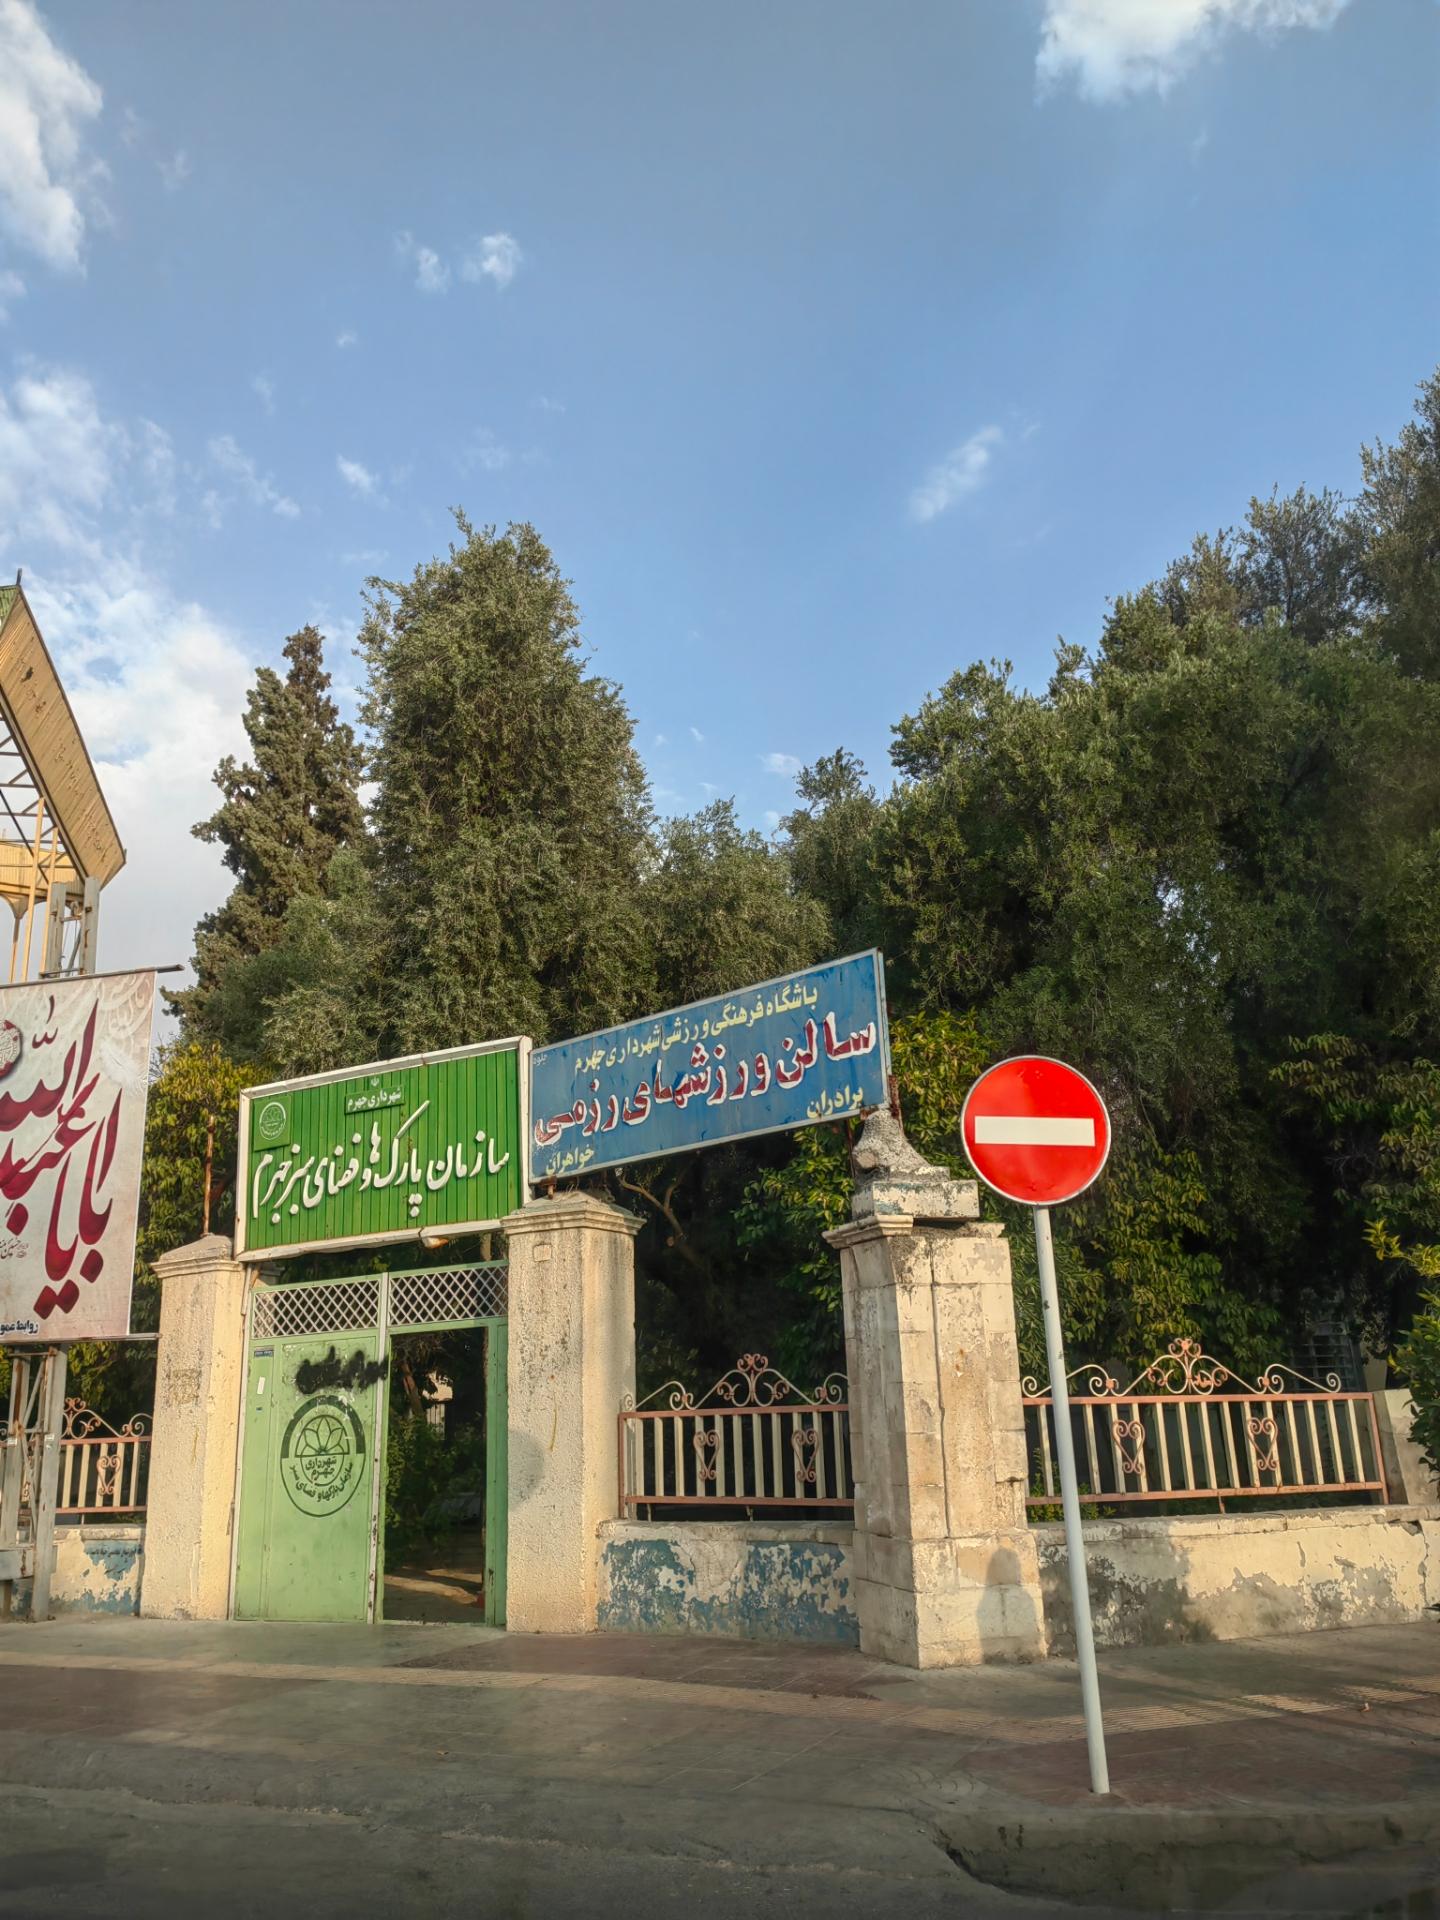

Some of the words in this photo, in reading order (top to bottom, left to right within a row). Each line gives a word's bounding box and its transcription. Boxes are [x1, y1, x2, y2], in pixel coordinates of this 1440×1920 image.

[711, 995, 764, 1036] فرهنگی
[766, 983, 818, 1016] باشگاه
[605, 1024, 660, 1067] شهرداری
[775, 1011, 876, 1089] سالن
[575, 1049, 606, 1079] جهرم
[347, 1096, 367, 1112] جهرم
[367, 1086, 401, 1108] شهرداری
[534, 1078, 619, 1146] رزمی
[806, 1084, 864, 1119] برادران
[303, 1132, 361, 1208] فضای
[426, 1131, 510, 1190] سازمان
[545, 1144, 595, 1176] خواهران
[253, 1153, 293, 1224] جهرم
[273, 1143, 316, 1216] سبز
[359, 1168, 372, 1191] و
[17, 1319, 39, 1334] روابط
[305, 1456, 337, 1471] شهرداری
[310, 1468, 335, 1481] جهرم
